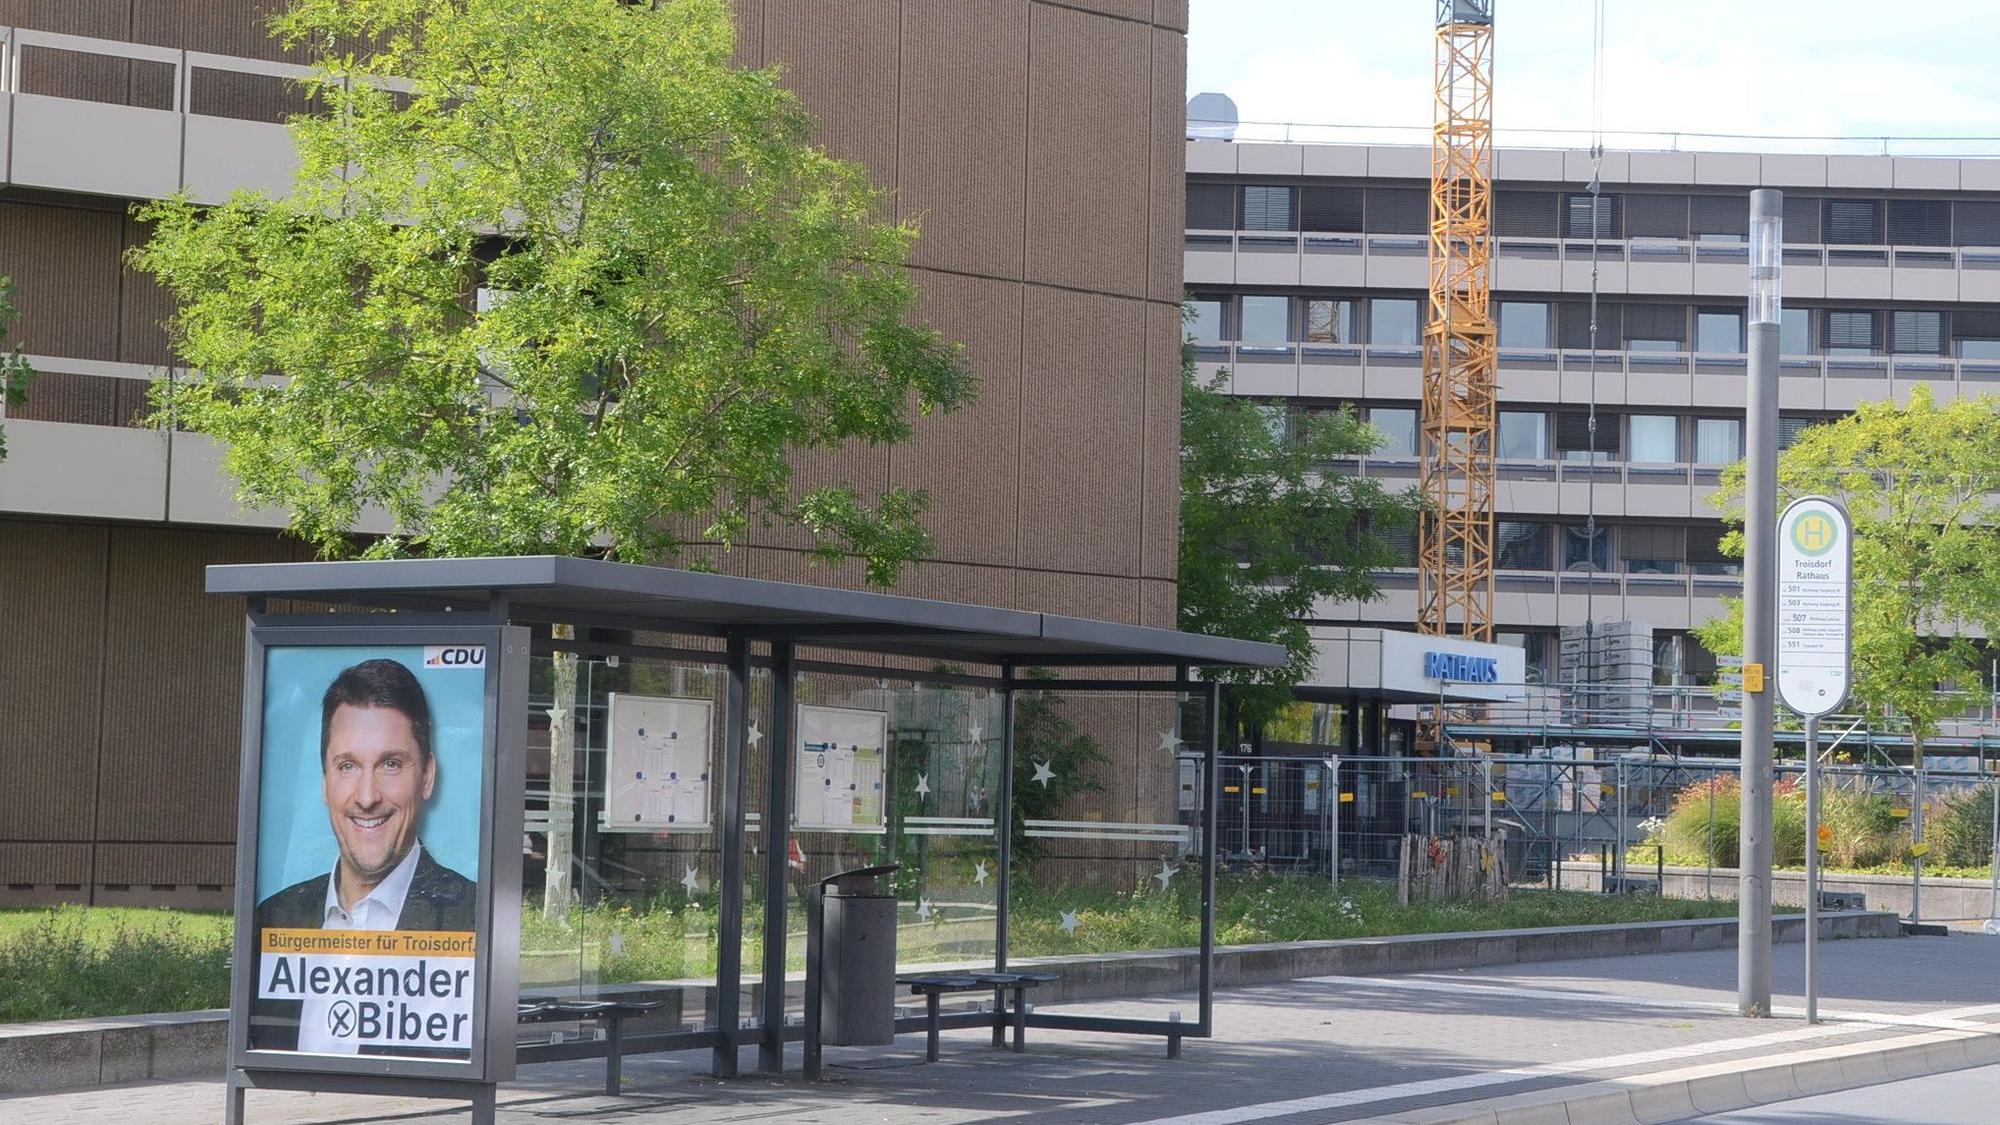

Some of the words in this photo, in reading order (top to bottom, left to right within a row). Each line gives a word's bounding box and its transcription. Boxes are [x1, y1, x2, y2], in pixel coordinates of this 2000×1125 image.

[1794, 560, 1832, 568] Troisdorf
[1796, 571, 1830, 580] Rathaus
[1788, 585, 1801, 593] 501
[1788, 599, 1801, 607] 503
[1792, 613, 1807, 622] 507
[441, 648, 485, 665] CDU
[1424, 652, 1498, 683] RATHAUS
[268, 932, 373, 952] Bürgermeister
[376, 934, 399, 950] für
[267, 956, 470, 999] Alexander
[357, 1000, 469, 1042] Biber
